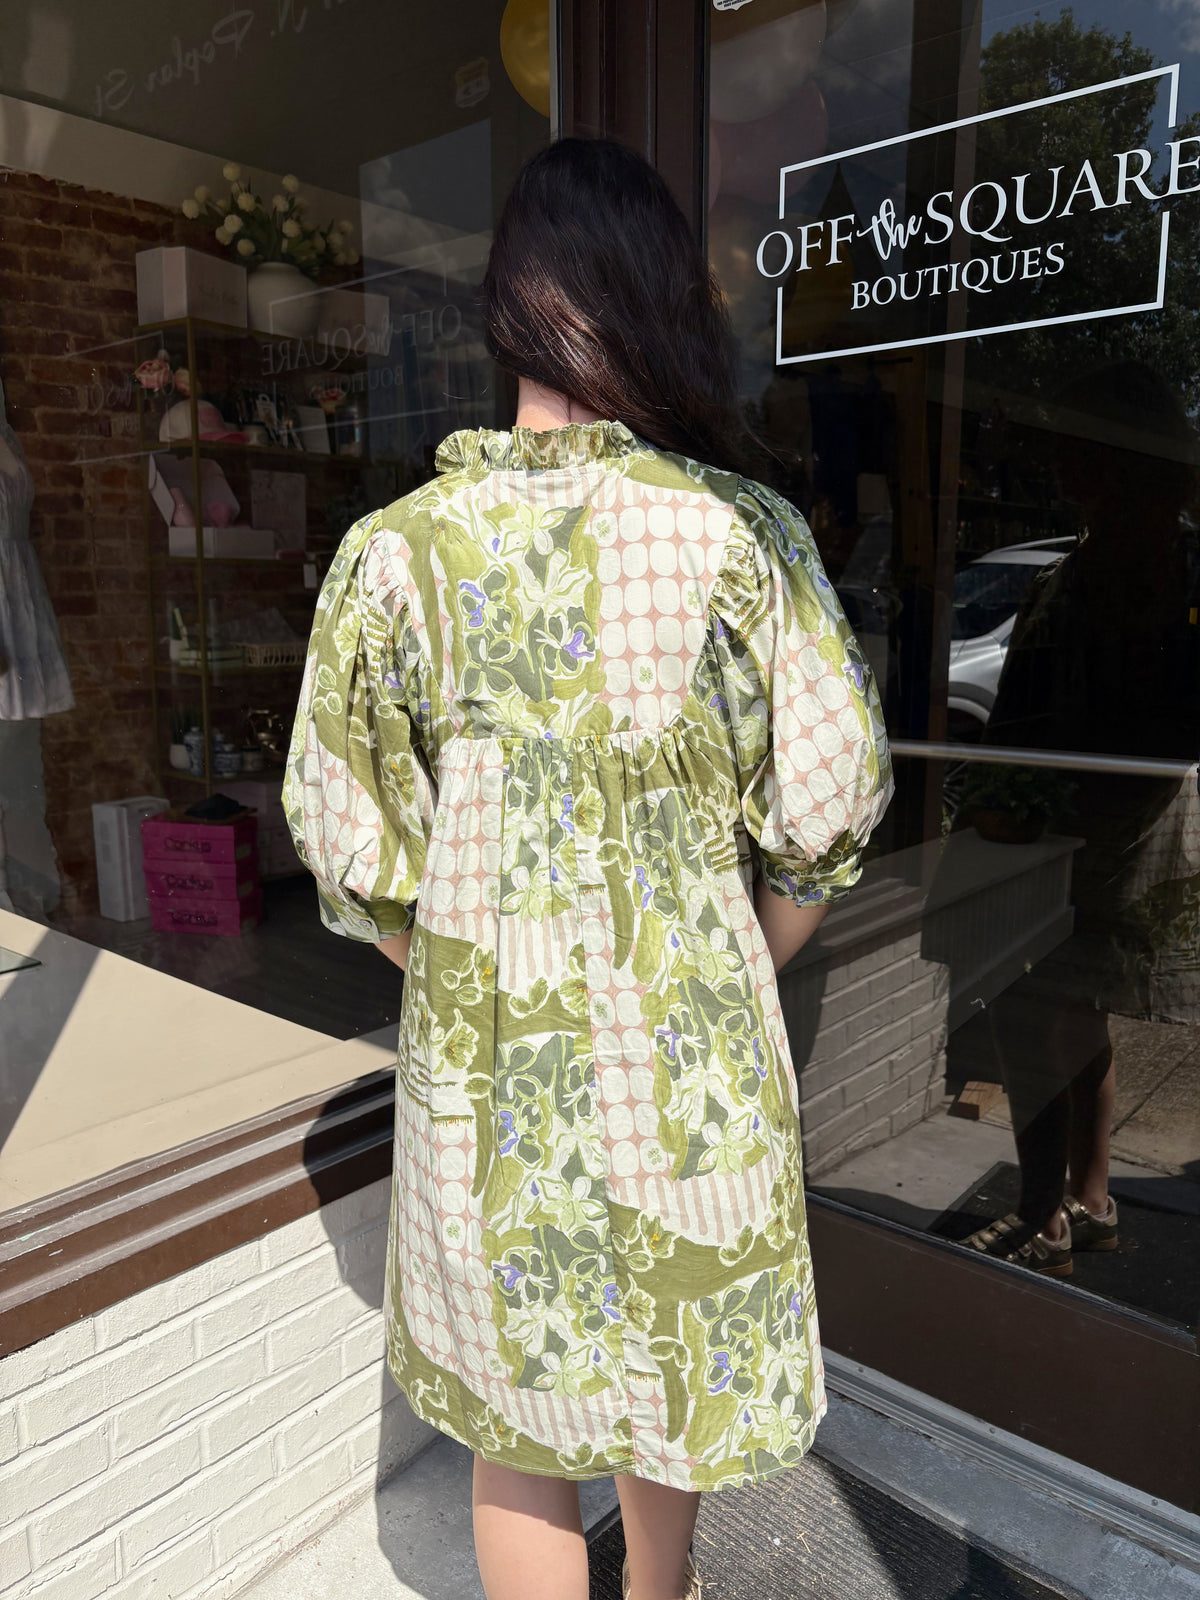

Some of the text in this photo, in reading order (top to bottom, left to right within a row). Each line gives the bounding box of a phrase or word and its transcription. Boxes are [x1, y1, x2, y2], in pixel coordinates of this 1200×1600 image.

[755, 135, 1200, 279] OFF the SQUARE
[850, 242, 1066, 311] BOUTIQUES
